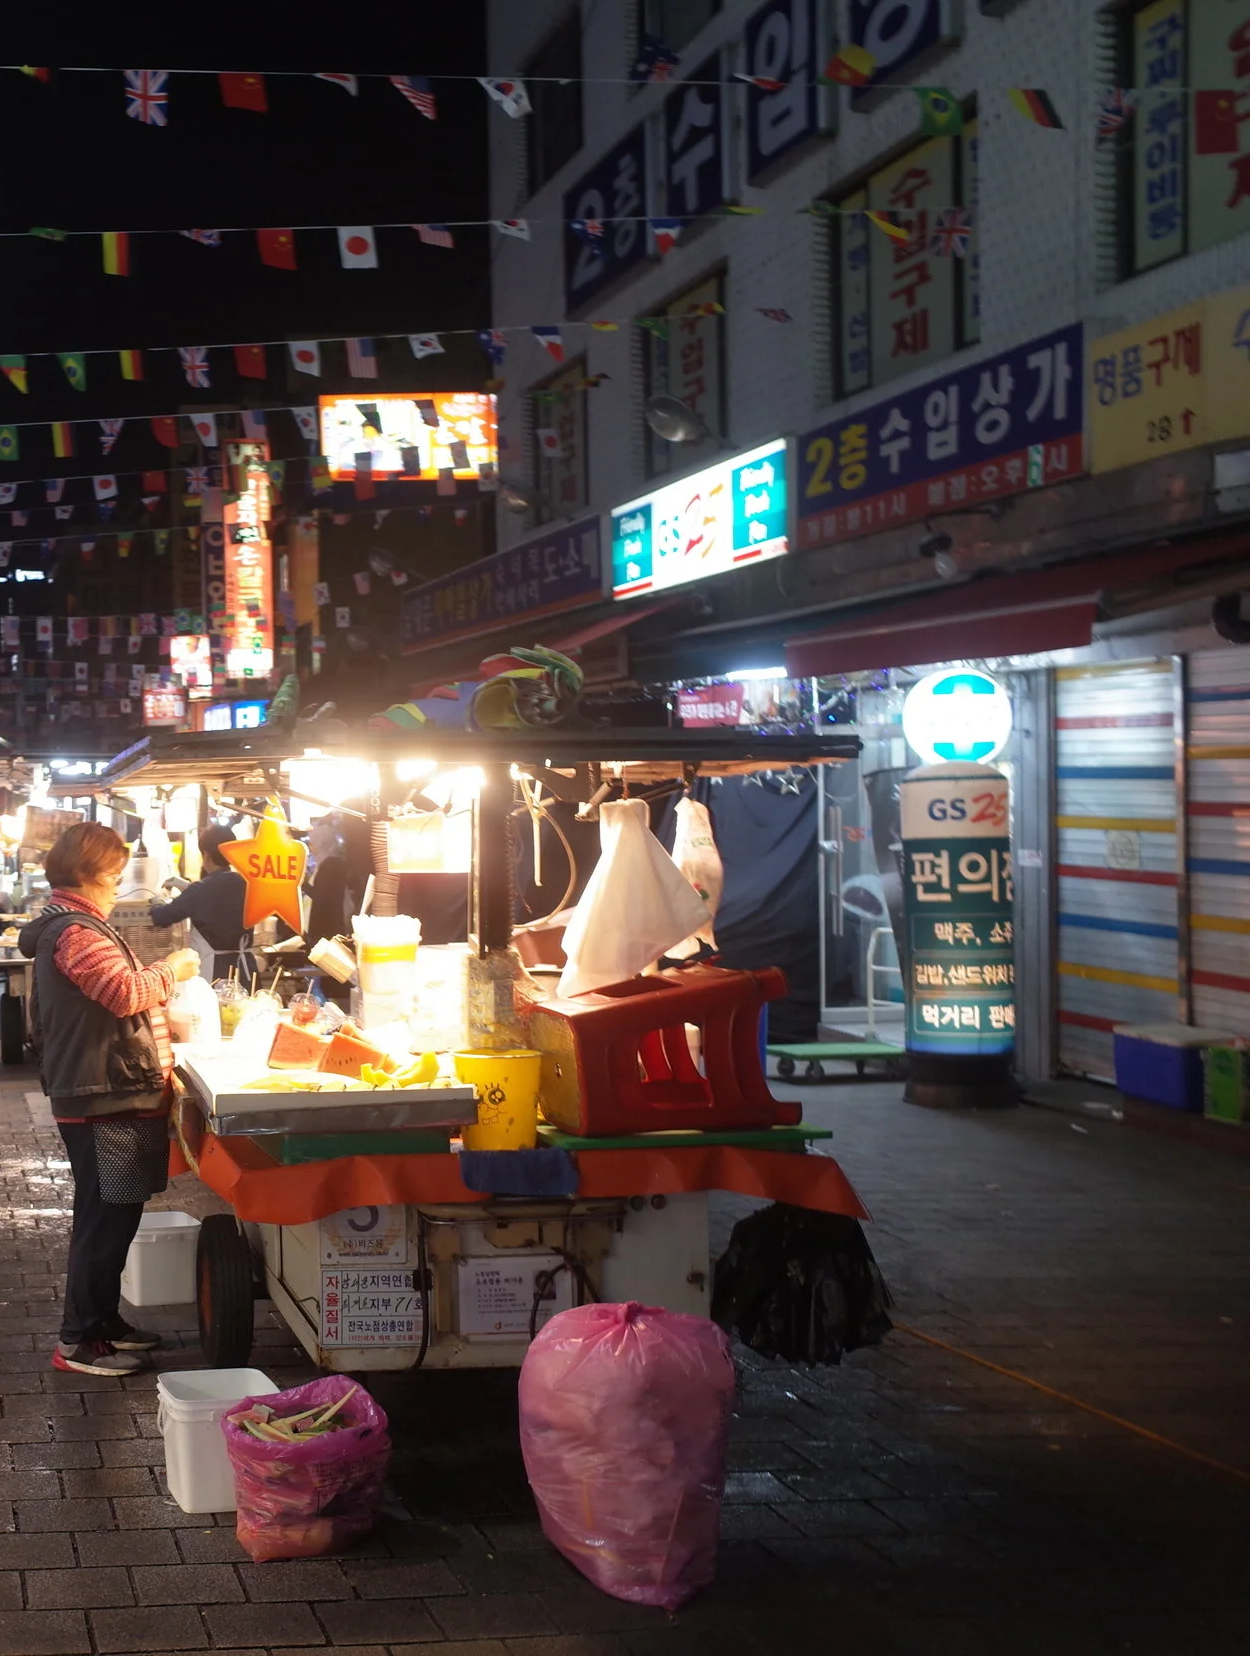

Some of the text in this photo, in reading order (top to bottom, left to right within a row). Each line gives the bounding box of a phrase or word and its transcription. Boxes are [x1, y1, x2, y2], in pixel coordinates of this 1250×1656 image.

[804, 341, 1073, 499] 2층 수입상가
[927, 792, 1008, 827] GS25
[247, 853, 298, 881] SALE
[933, 921, 982, 946] 맥주,
[914, 962, 1014, 984] 김밥,샌드위치
[921, 1001, 981, 1027] 먹거리
[325, 1276, 339, 1341] 자율질서
